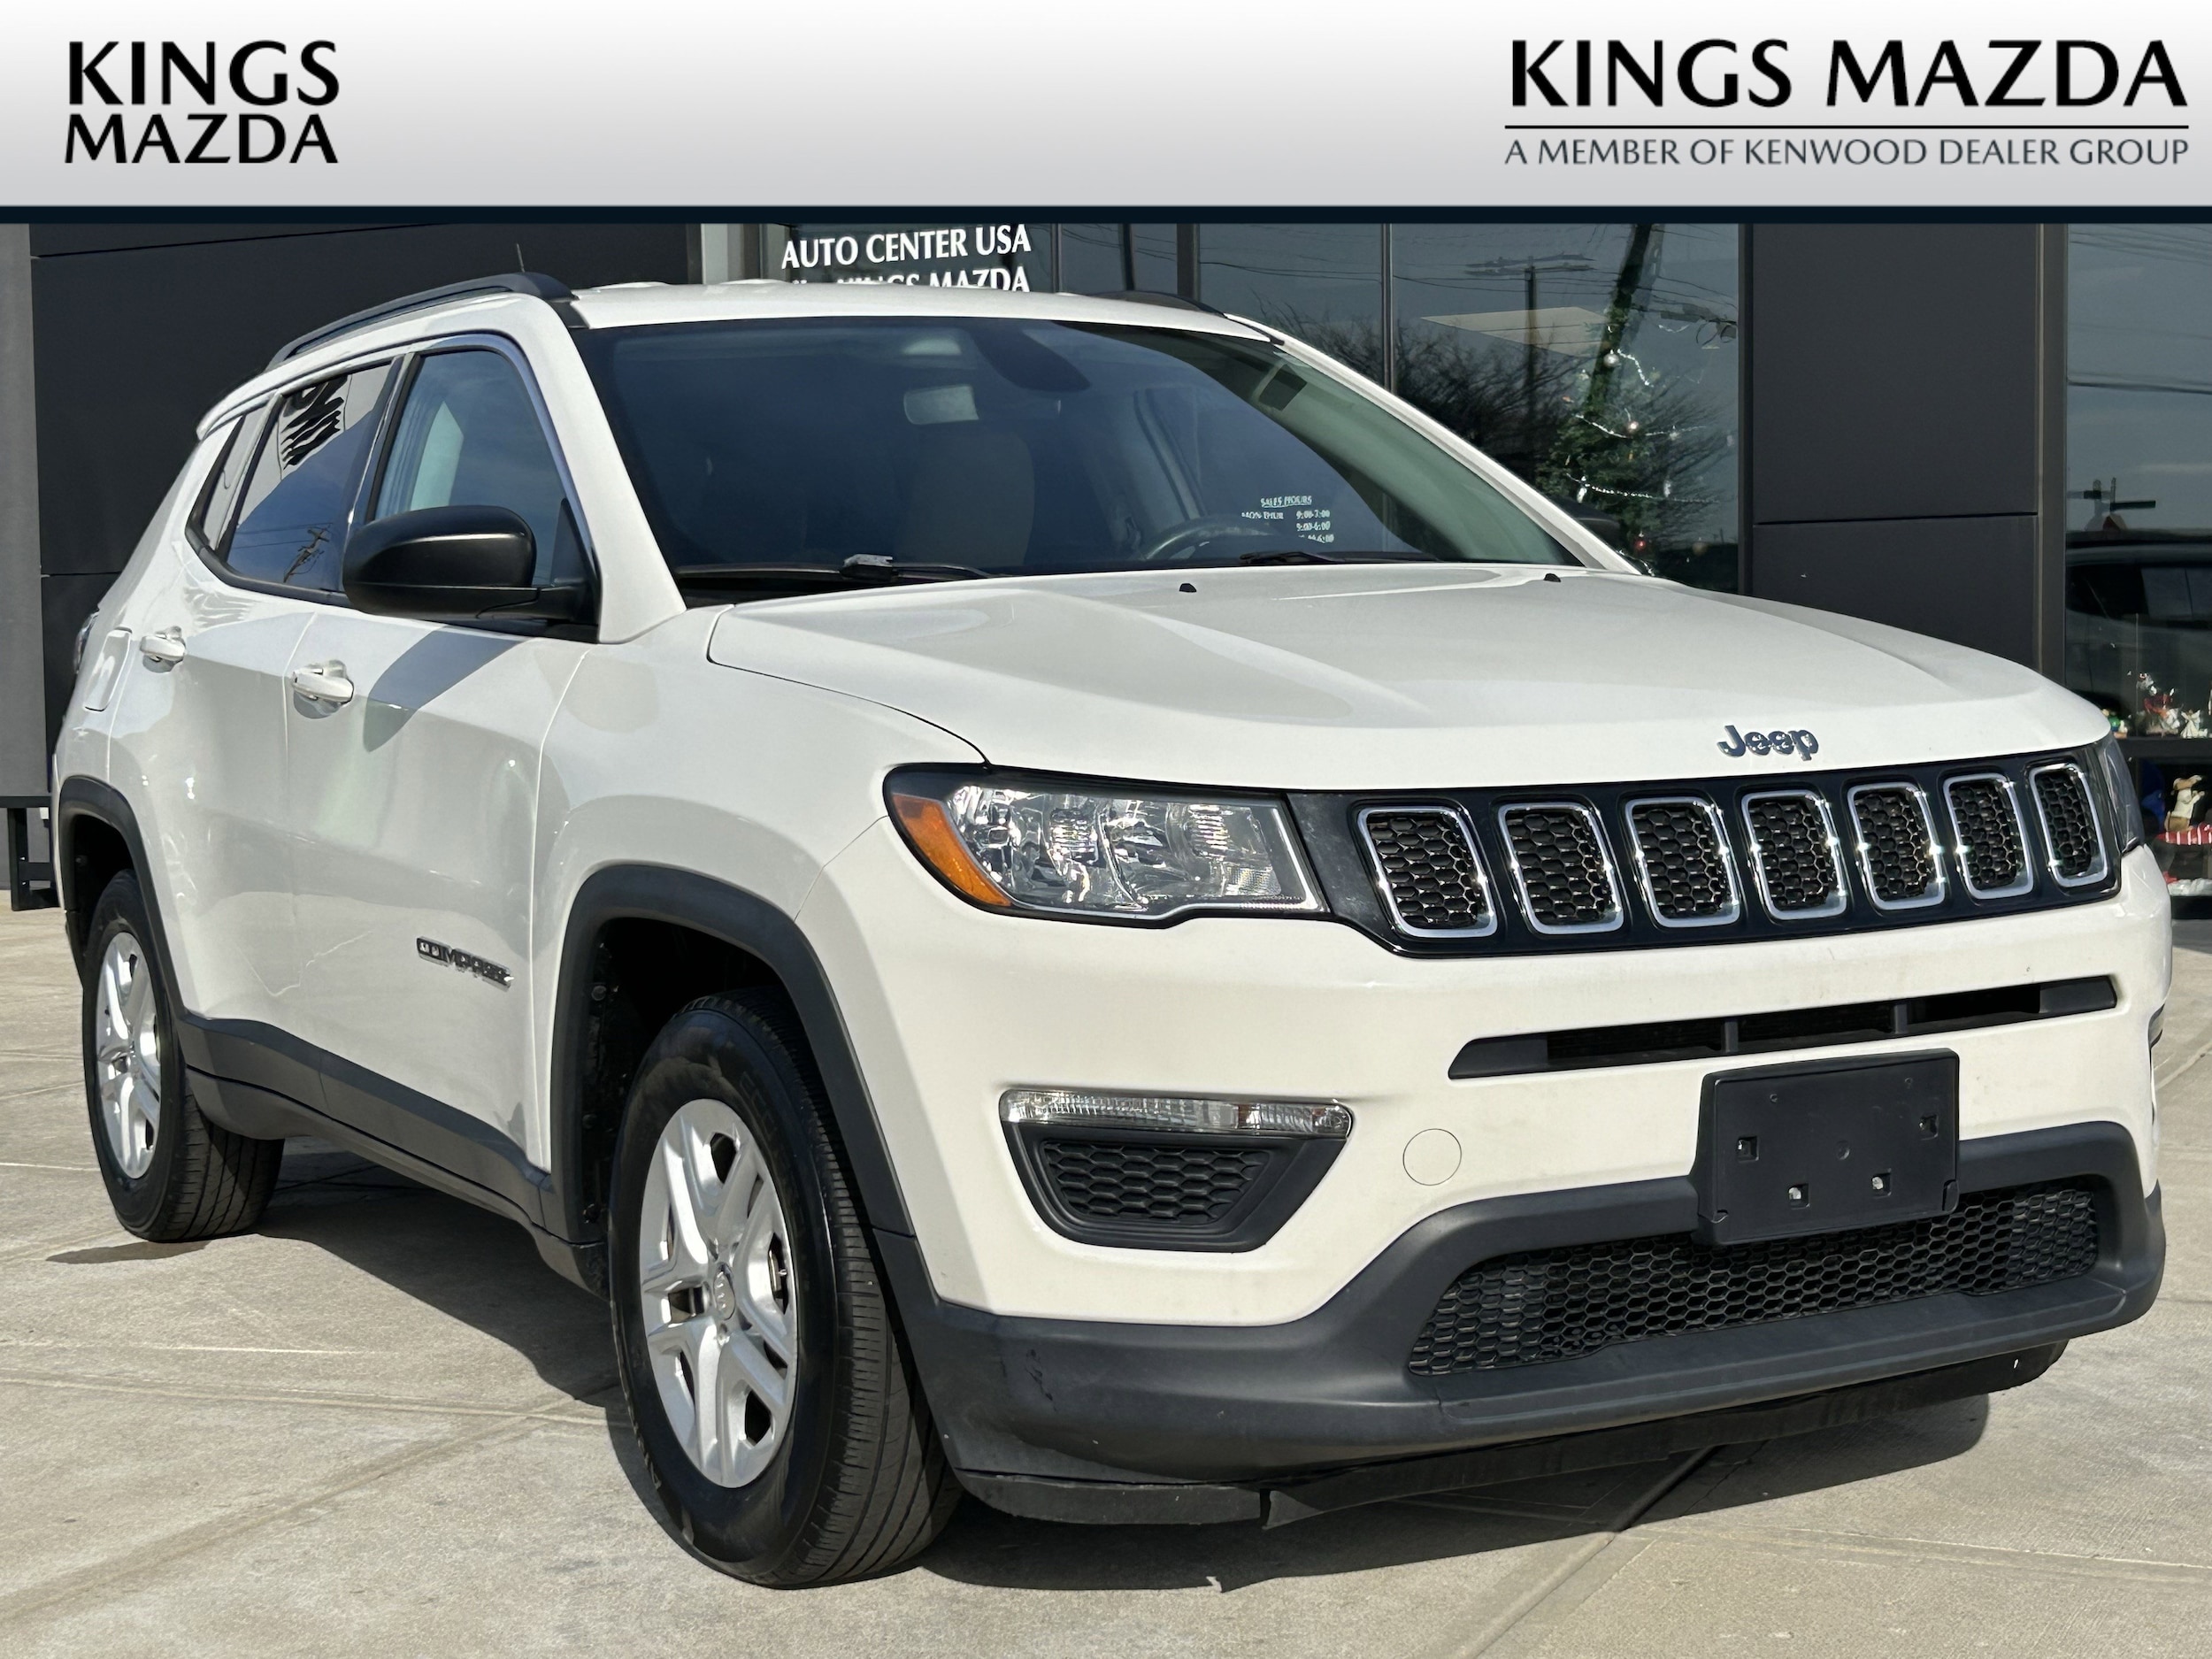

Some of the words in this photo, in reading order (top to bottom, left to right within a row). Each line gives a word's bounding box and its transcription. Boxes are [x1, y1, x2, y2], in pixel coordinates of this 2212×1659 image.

[781, 235, 858, 269] AUTO
[865, 228, 968, 264] CENTER
[975, 224, 1032, 257] USA
[1717, 725, 1819, 762] Jeep
